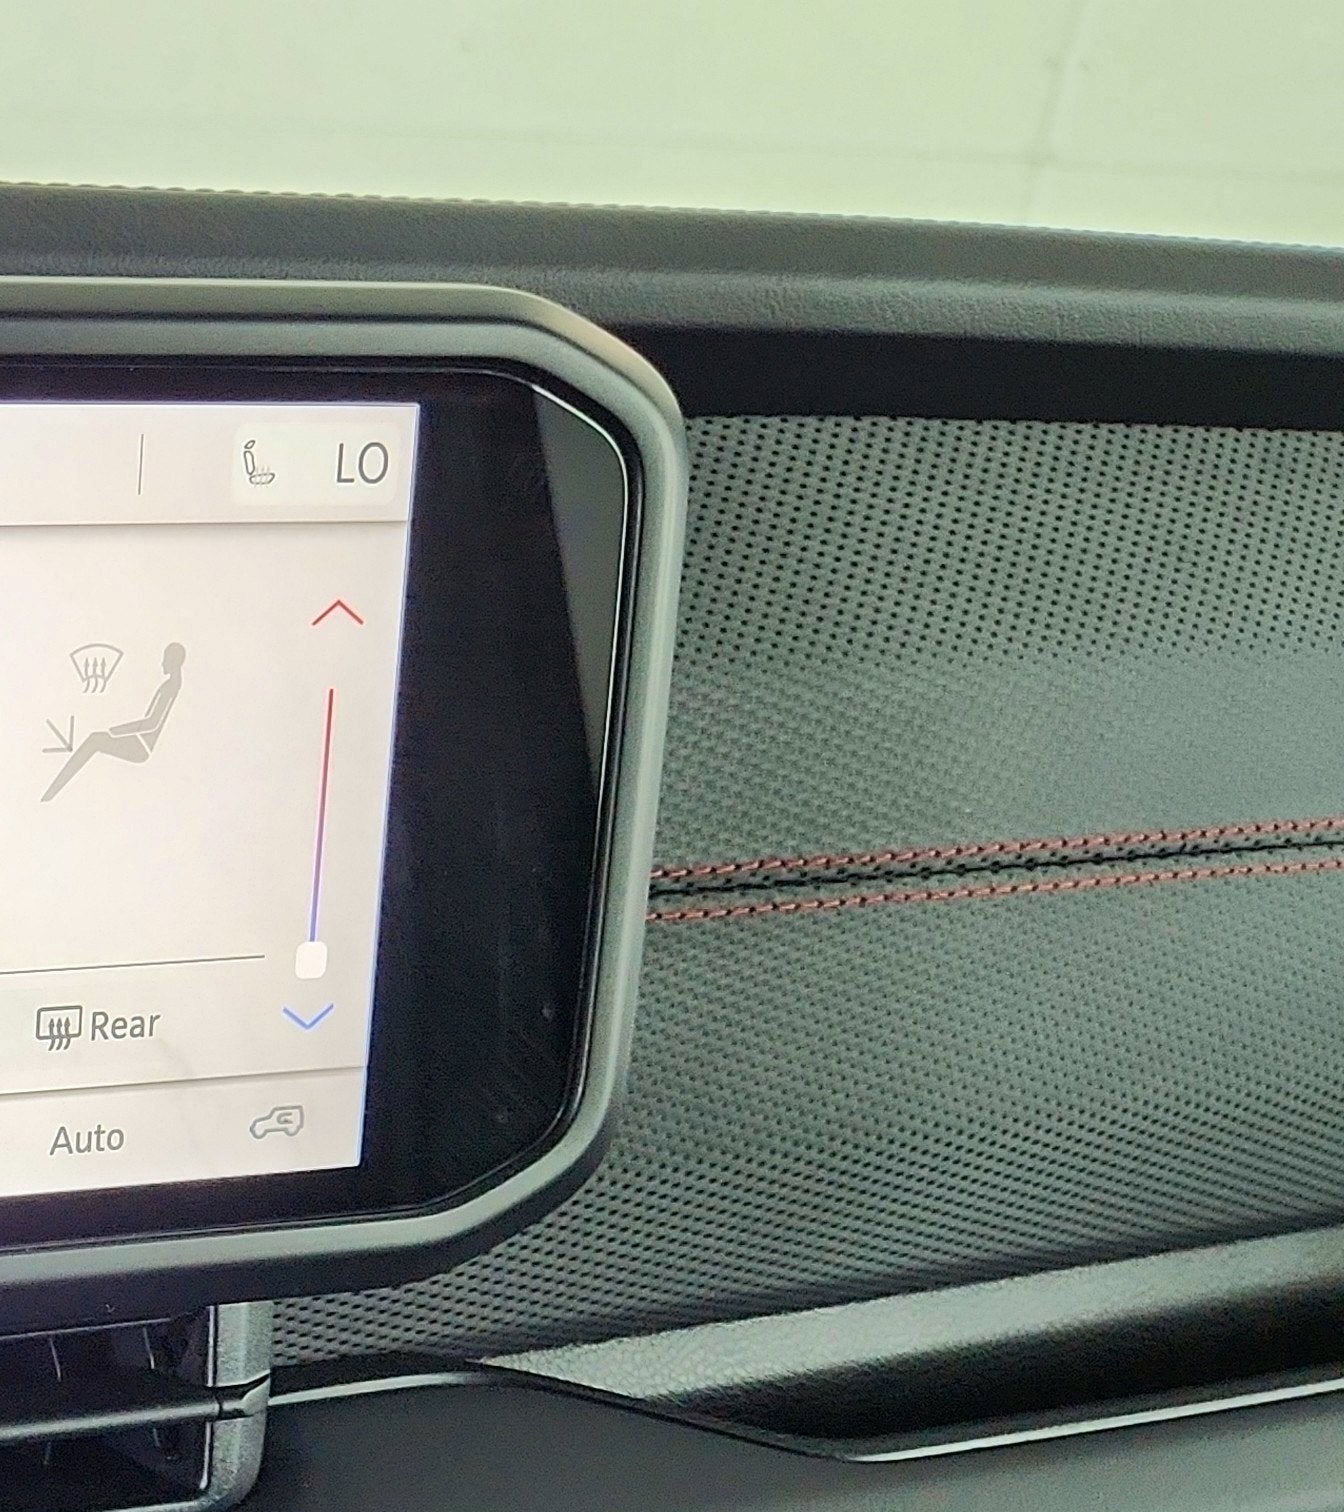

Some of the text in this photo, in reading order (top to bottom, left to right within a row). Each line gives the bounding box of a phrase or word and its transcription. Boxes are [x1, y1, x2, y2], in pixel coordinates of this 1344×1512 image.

[335, 441, 389, 486] LO
[89, 1008, 161, 1042] Rear
[49, 1122, 126, 1157] Auto
